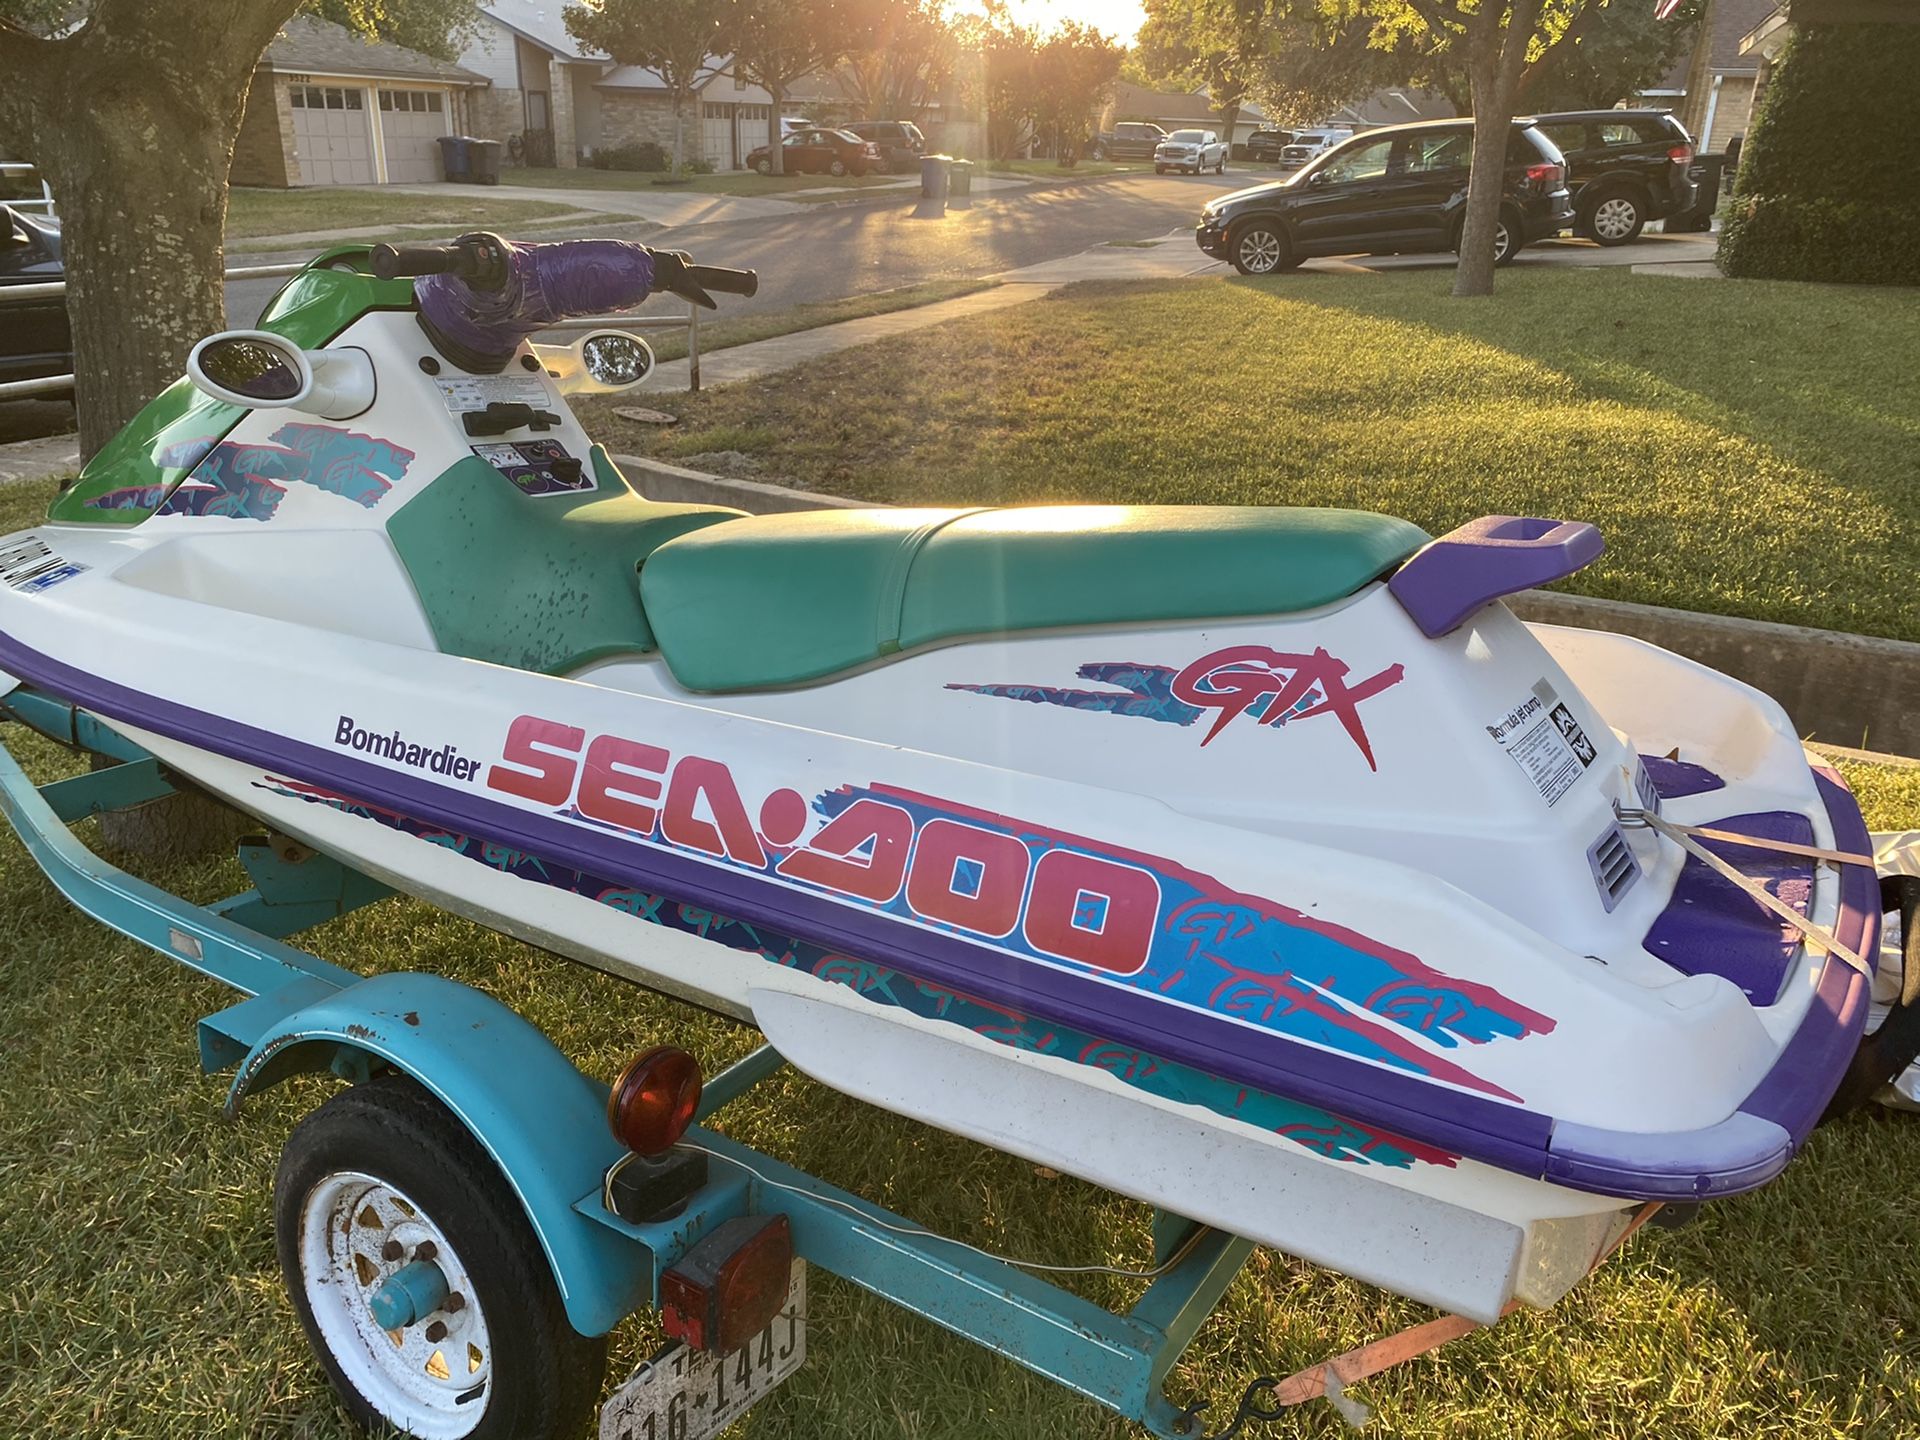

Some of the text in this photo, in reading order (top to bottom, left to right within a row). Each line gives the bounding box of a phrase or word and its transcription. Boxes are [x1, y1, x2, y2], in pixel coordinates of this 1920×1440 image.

[517, 473, 541, 486] GTX
[1171, 645, 1405, 772] GTX
[1513, 705, 1528, 725] jet
[1523, 696, 1542, 718] pump
[335, 715, 481, 782] Bombardier
